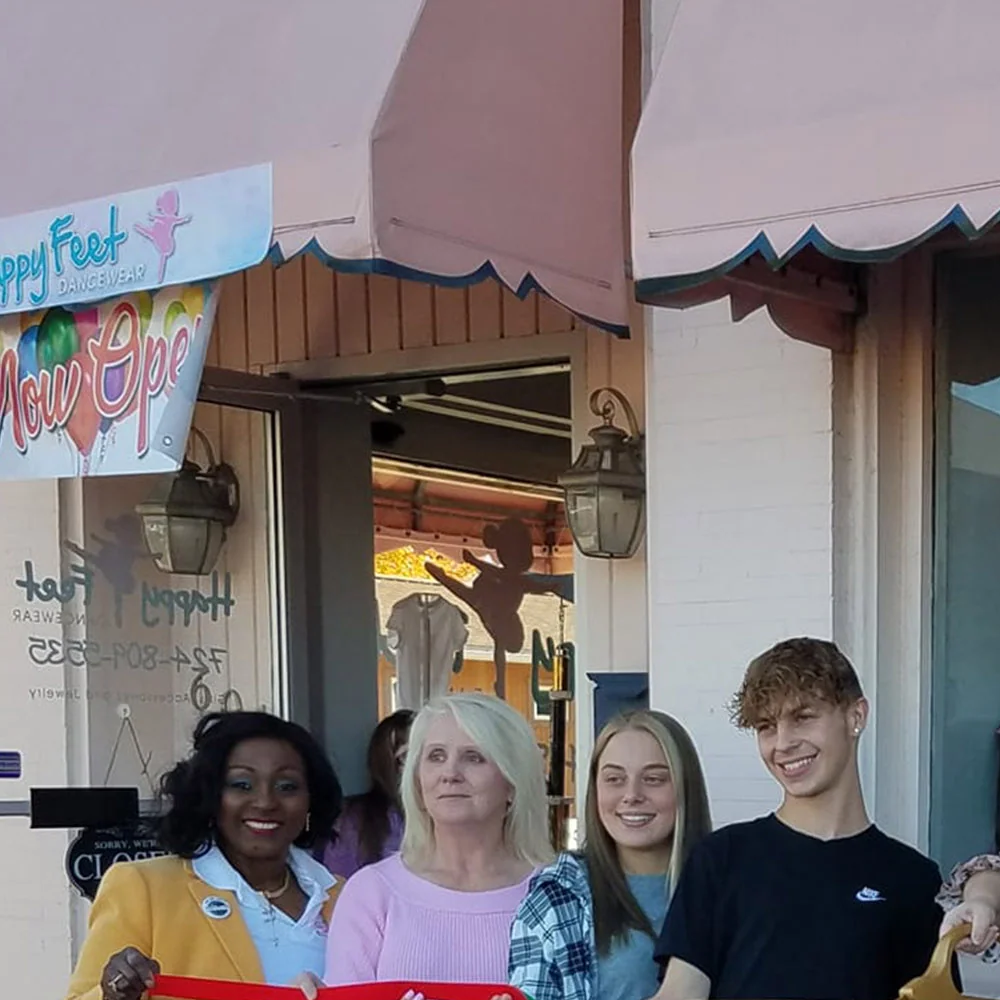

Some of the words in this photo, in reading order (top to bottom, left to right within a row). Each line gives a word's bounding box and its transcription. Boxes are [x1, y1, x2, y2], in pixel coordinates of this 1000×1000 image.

[0, 241, 48, 306] ppy
[49, 204, 128, 276] Feet
[58, 264, 146, 296] DANCEWEAR
[88, 302, 202, 456] Ope
[94, 840, 131, 850] SORRY,
